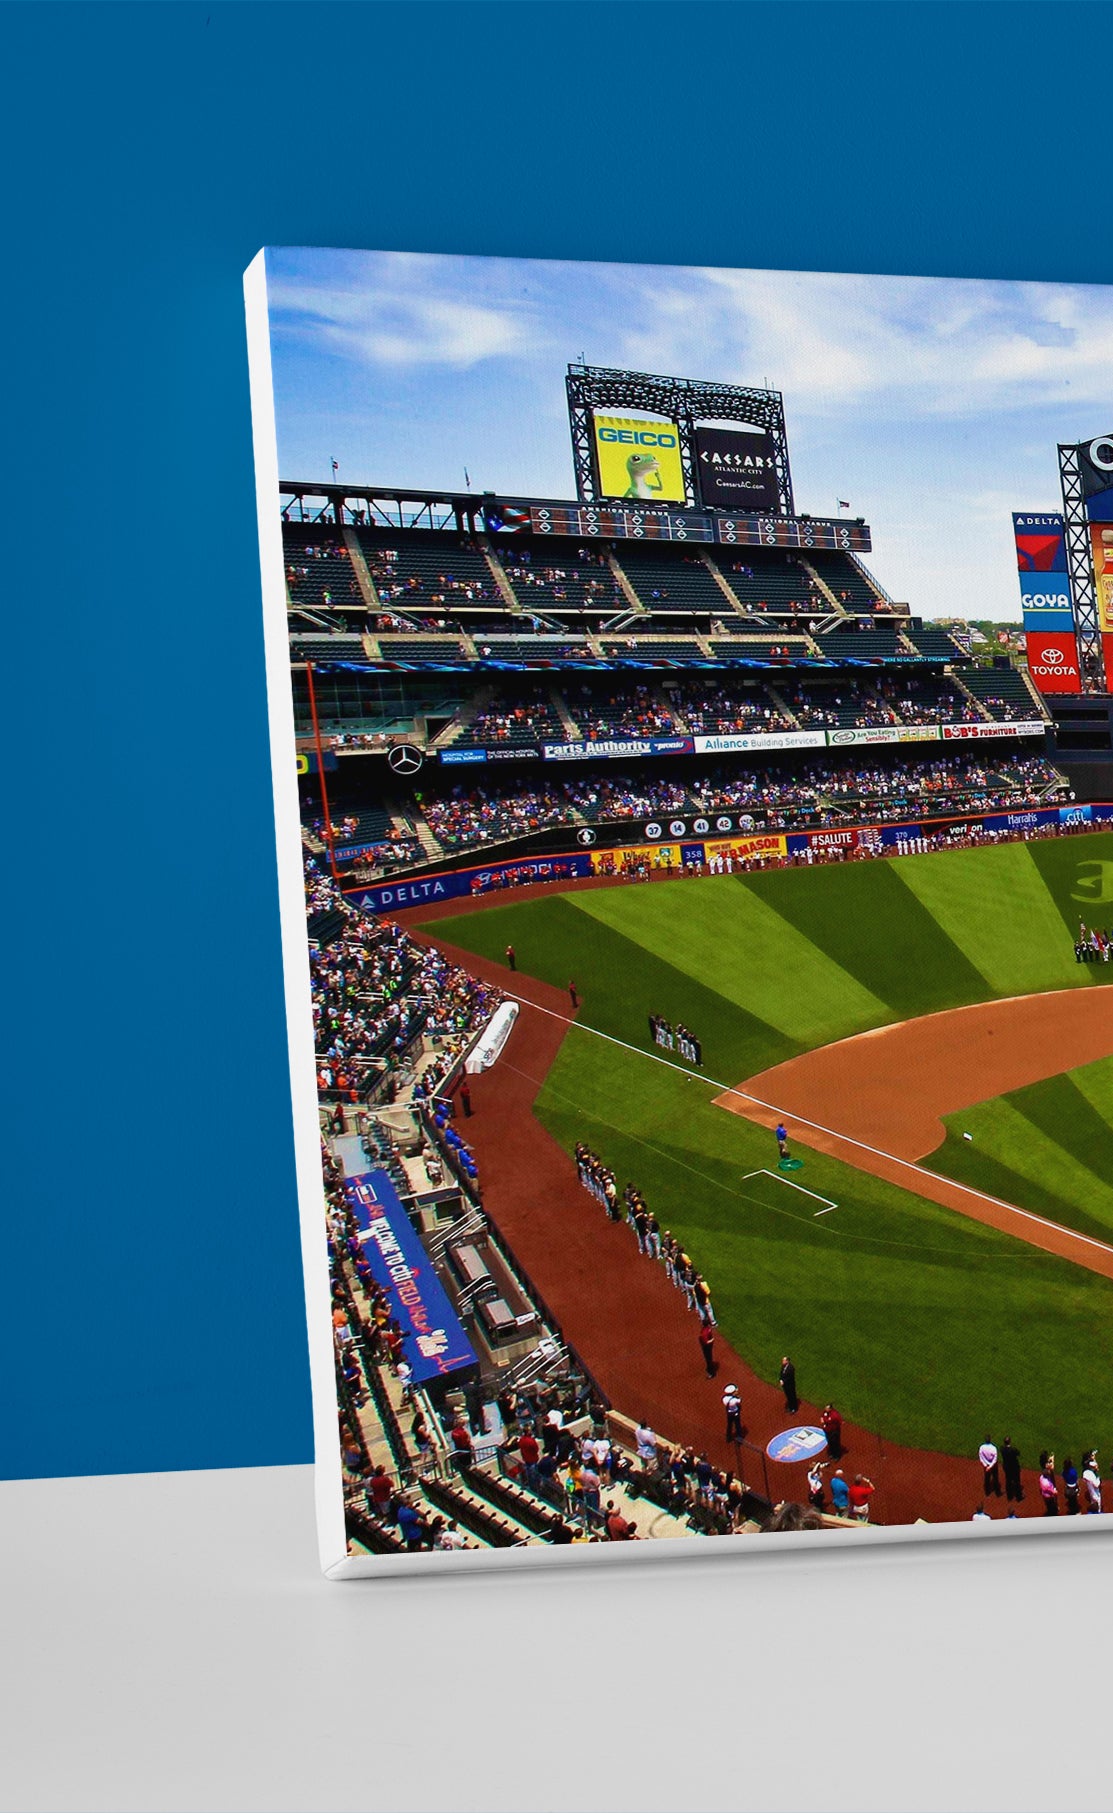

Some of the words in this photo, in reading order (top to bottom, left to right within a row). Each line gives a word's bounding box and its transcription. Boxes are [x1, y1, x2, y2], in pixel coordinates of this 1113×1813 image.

[598, 428, 676, 448] GEICO
[700, 451, 774, 468] CAESARS
[714, 466, 745, 474] ATLANTIC
[1027, 517, 1060, 526] DELTA
[1022, 594, 1070, 608] GOYA
[1032, 666, 1076, 676] TOYOTA
[878, 729, 896, 737] Eating
[944, 726, 979, 739] BOB'S
[980, 728, 1017, 736] FURNITURE
[544, 743, 583, 758] Parts
[586, 740, 651, 755] Authority
[705, 737, 749, 749] Alliance
[751, 738, 784, 748] Building
[785, 736, 818, 746] Services
[719, 820, 729, 828] 42
[1007, 812, 1038, 825] Harrah's
[648, 827, 659, 836] 37
[674, 825, 682, 833] 14
[697, 822, 705, 830] 41
[812, 832, 853, 846] #SALUTE
[738, 838, 780, 856] MASON
[685, 850, 702, 859] 358
[381, 882, 445, 906] DELTA
[369, 1216, 395, 1259] WELCOME
[386, 1256, 405, 1267] TO
[397, 1279, 422, 1306] FIELD
